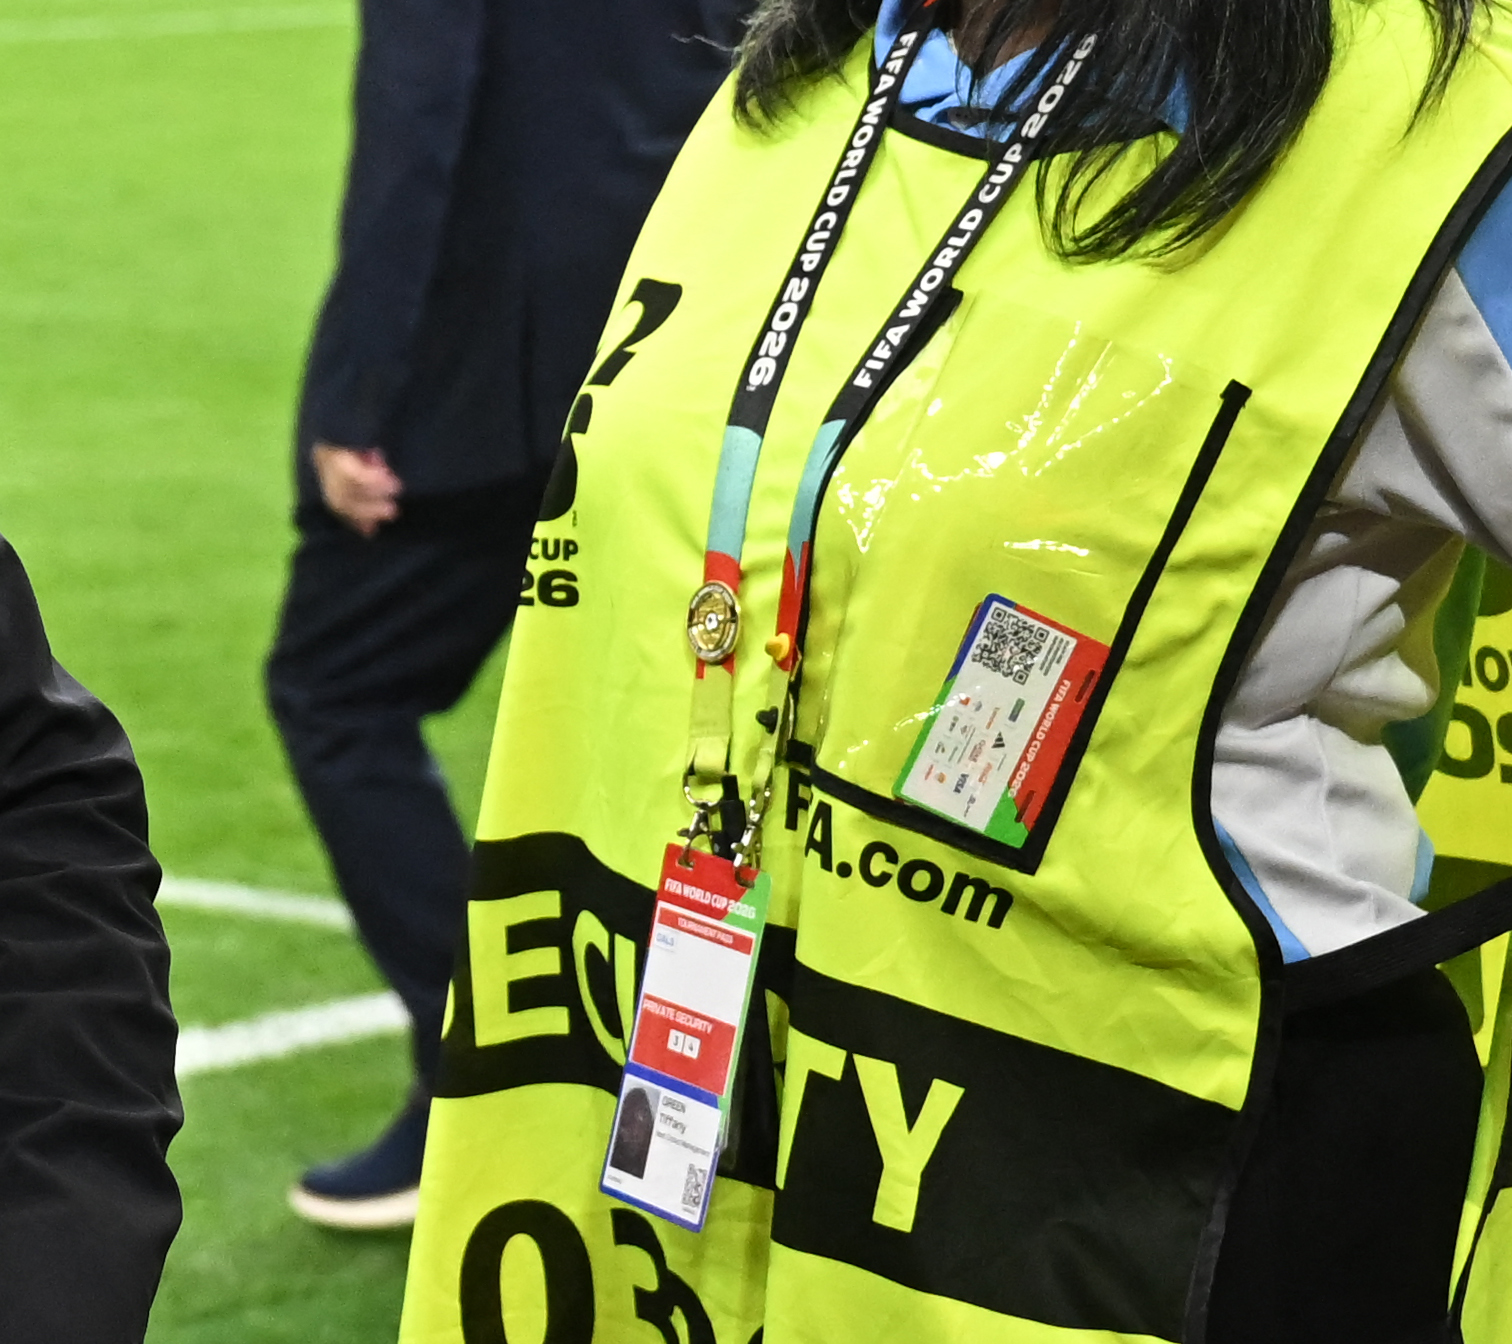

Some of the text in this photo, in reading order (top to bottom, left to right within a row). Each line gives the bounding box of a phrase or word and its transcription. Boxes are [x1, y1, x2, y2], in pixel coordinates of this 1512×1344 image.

[749, 30, 918, 388] FIFA WORLD CUP 2026
[852, 33, 1098, 390] FIFA WORLD CUP 2026
[1053, 678, 1071, 703] FIFA
[1035, 702, 1059, 741] WORLD
[1025, 740, 1042, 762] CUP
[952, 772, 970, 794] VISA
[664, 877, 684, 896] FIFA
[682, 883, 712, 905] WORLD
[710, 893, 728, 910] CUP
[642, 999, 714, 1035] PRIVATE SECURITY
